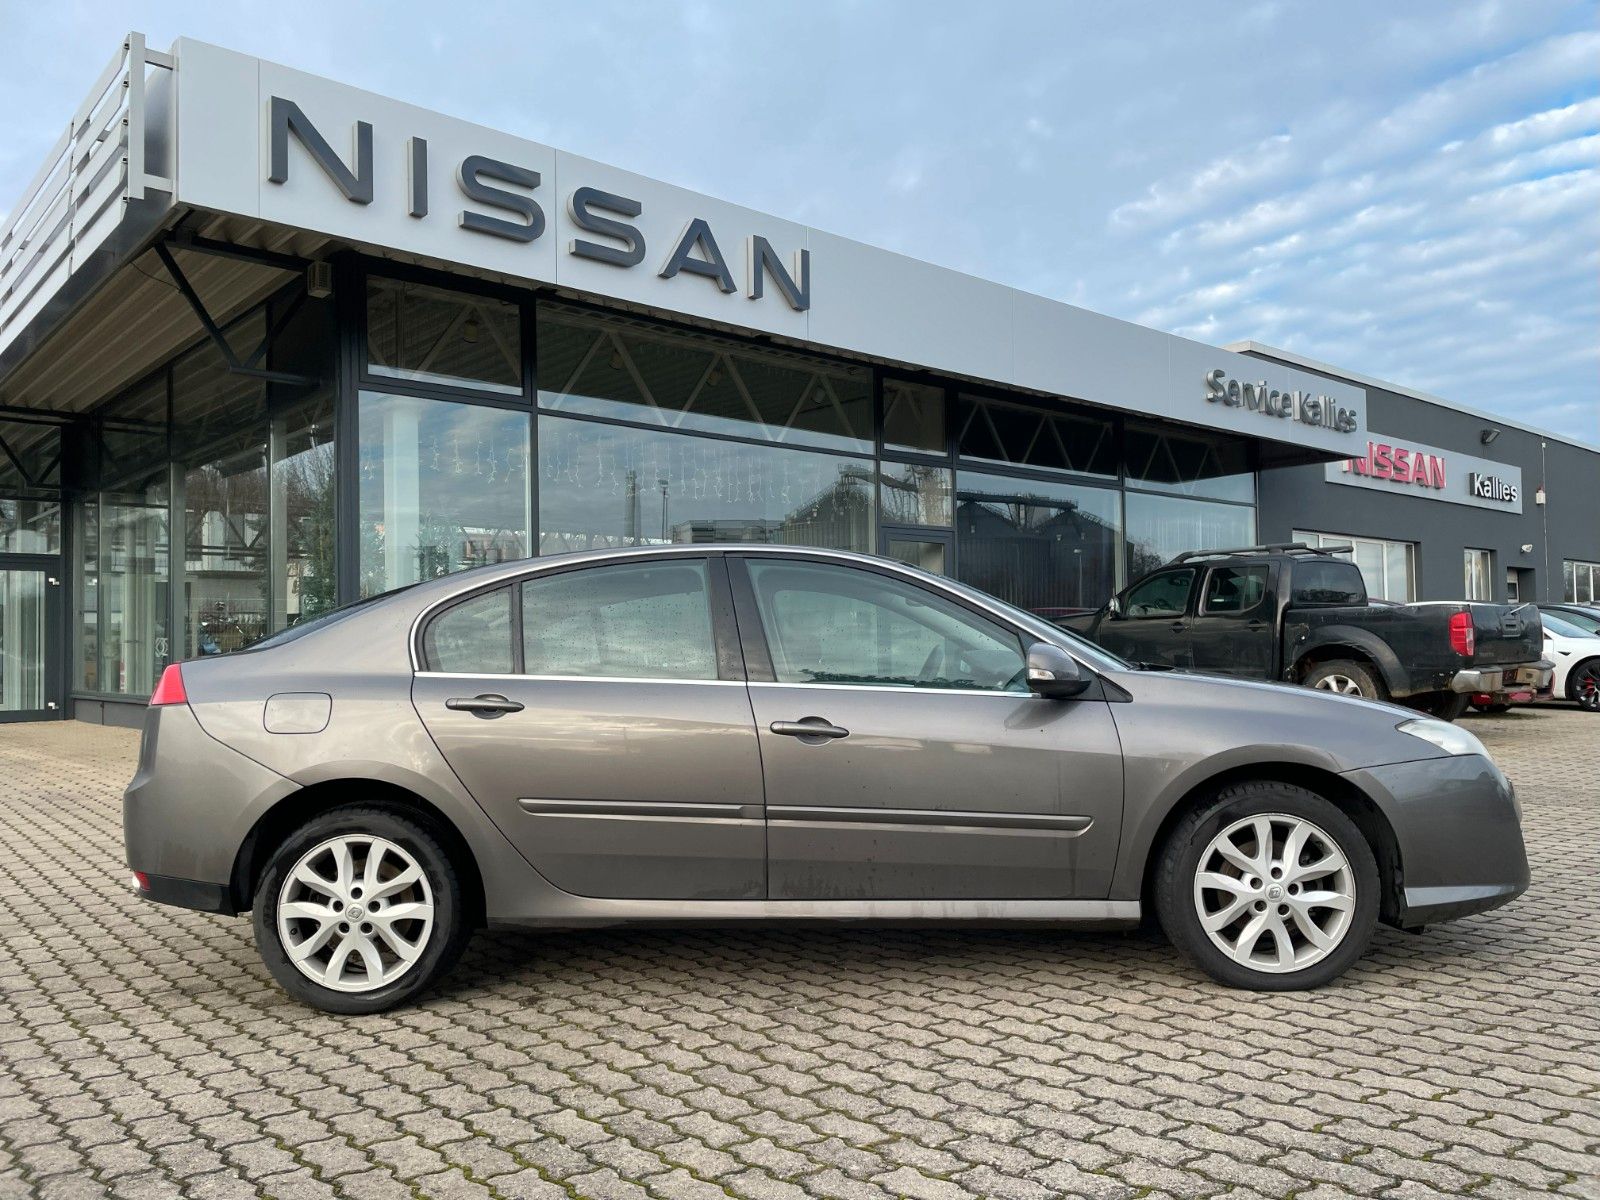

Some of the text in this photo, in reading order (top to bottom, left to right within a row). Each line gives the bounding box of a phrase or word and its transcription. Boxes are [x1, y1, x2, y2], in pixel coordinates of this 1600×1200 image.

[267, 95, 810, 312] NISSAN
[1206, 369, 1357, 433] Service Kallies
[1469, 472, 1518, 502] Kallies
